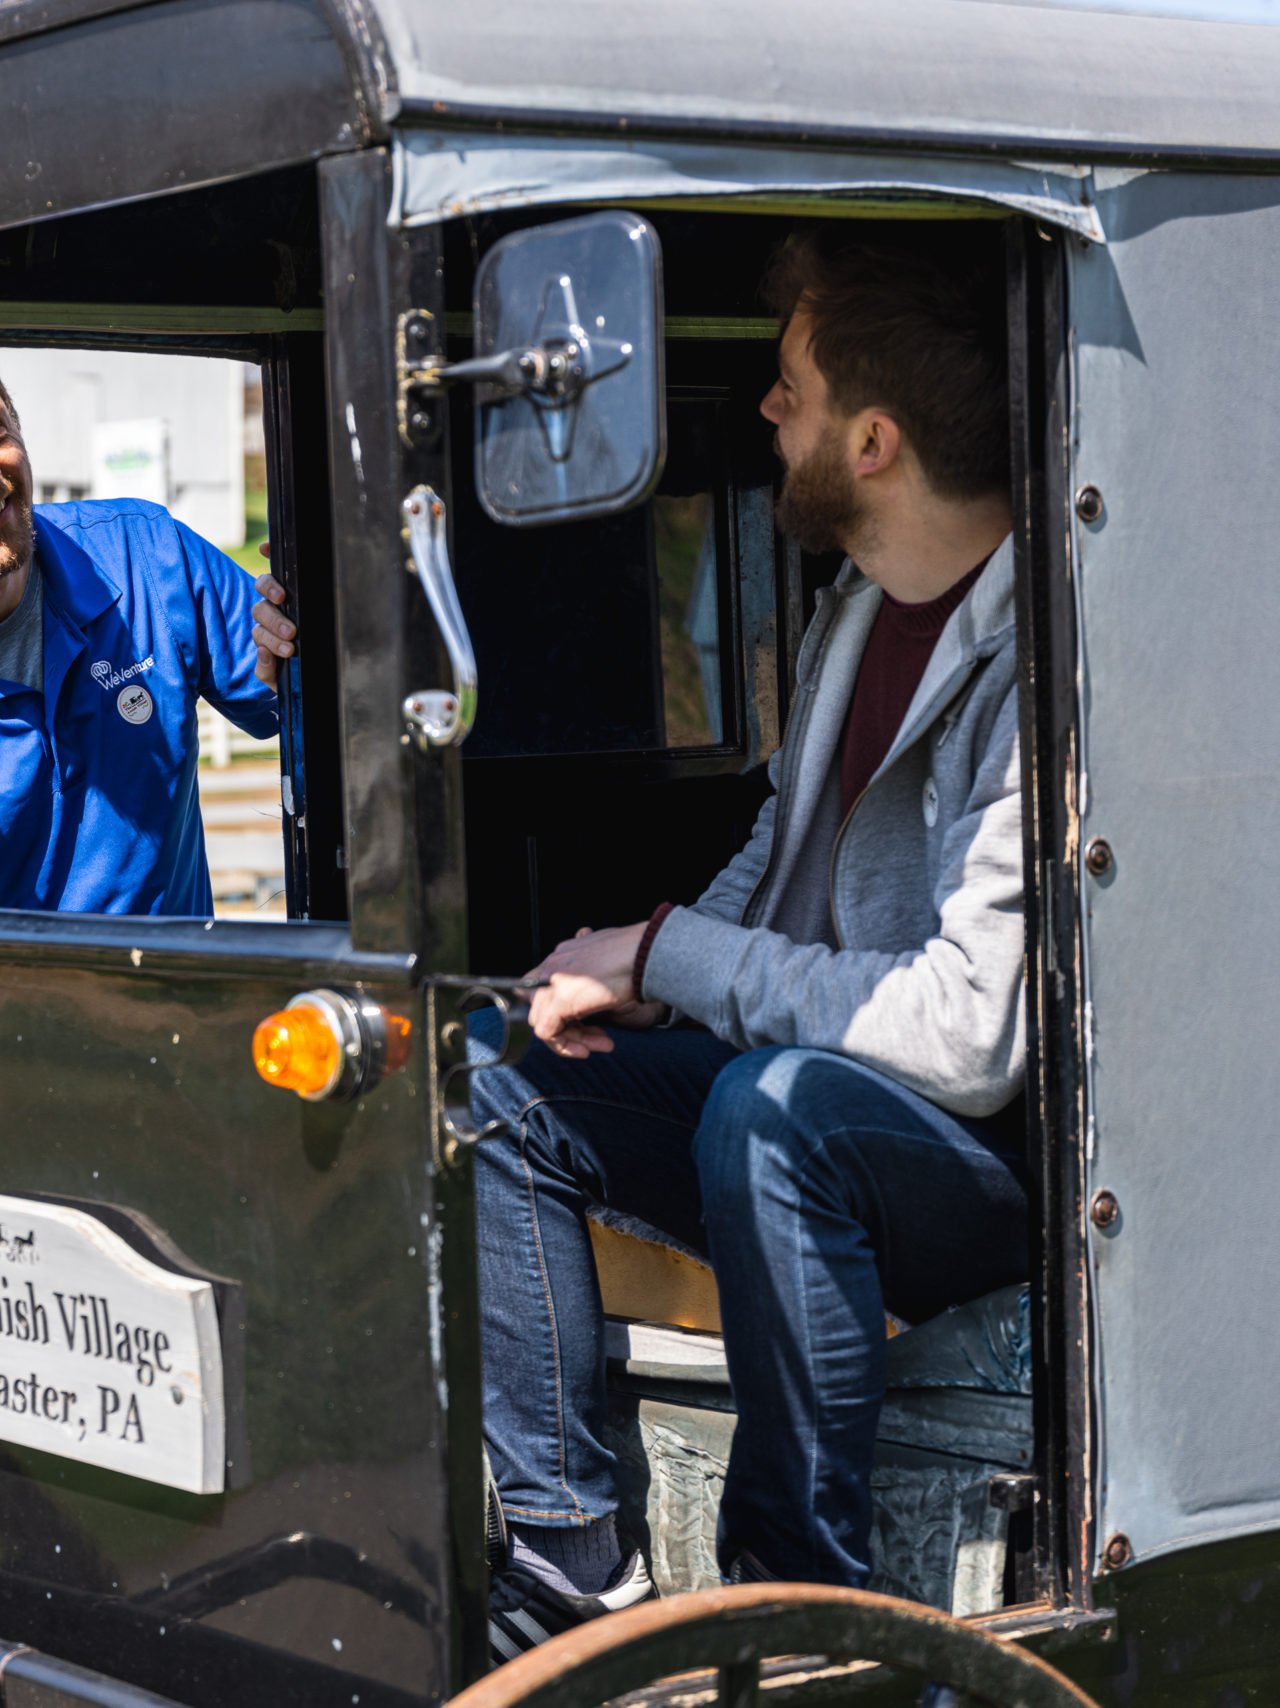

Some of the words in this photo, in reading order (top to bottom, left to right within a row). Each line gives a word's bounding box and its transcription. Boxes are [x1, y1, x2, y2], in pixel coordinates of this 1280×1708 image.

[97, 656, 155, 690] WeVenture
[52, 1291, 173, 1387] Village
[96, 1384, 145, 1444] PA
